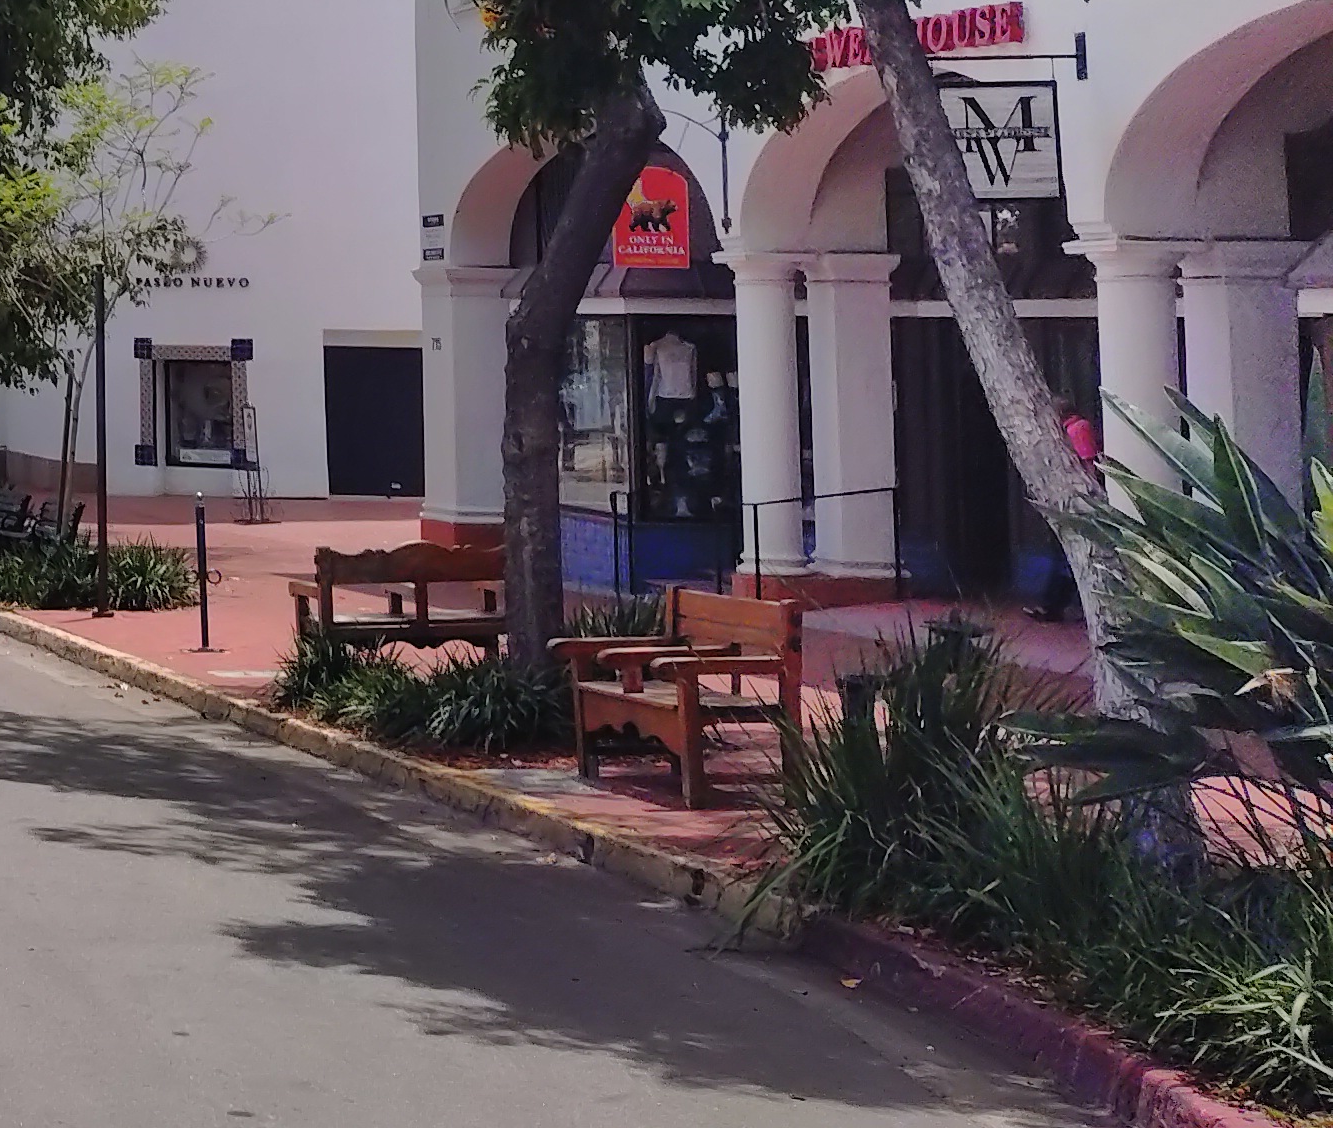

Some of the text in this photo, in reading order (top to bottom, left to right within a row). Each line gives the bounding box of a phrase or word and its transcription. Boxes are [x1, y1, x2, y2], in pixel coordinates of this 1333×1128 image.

[628, 234, 674, 245] ONLY IN
[617, 245, 686, 256] CALIFORNIA
[135, 276, 250, 288] PASEO NUEVO
